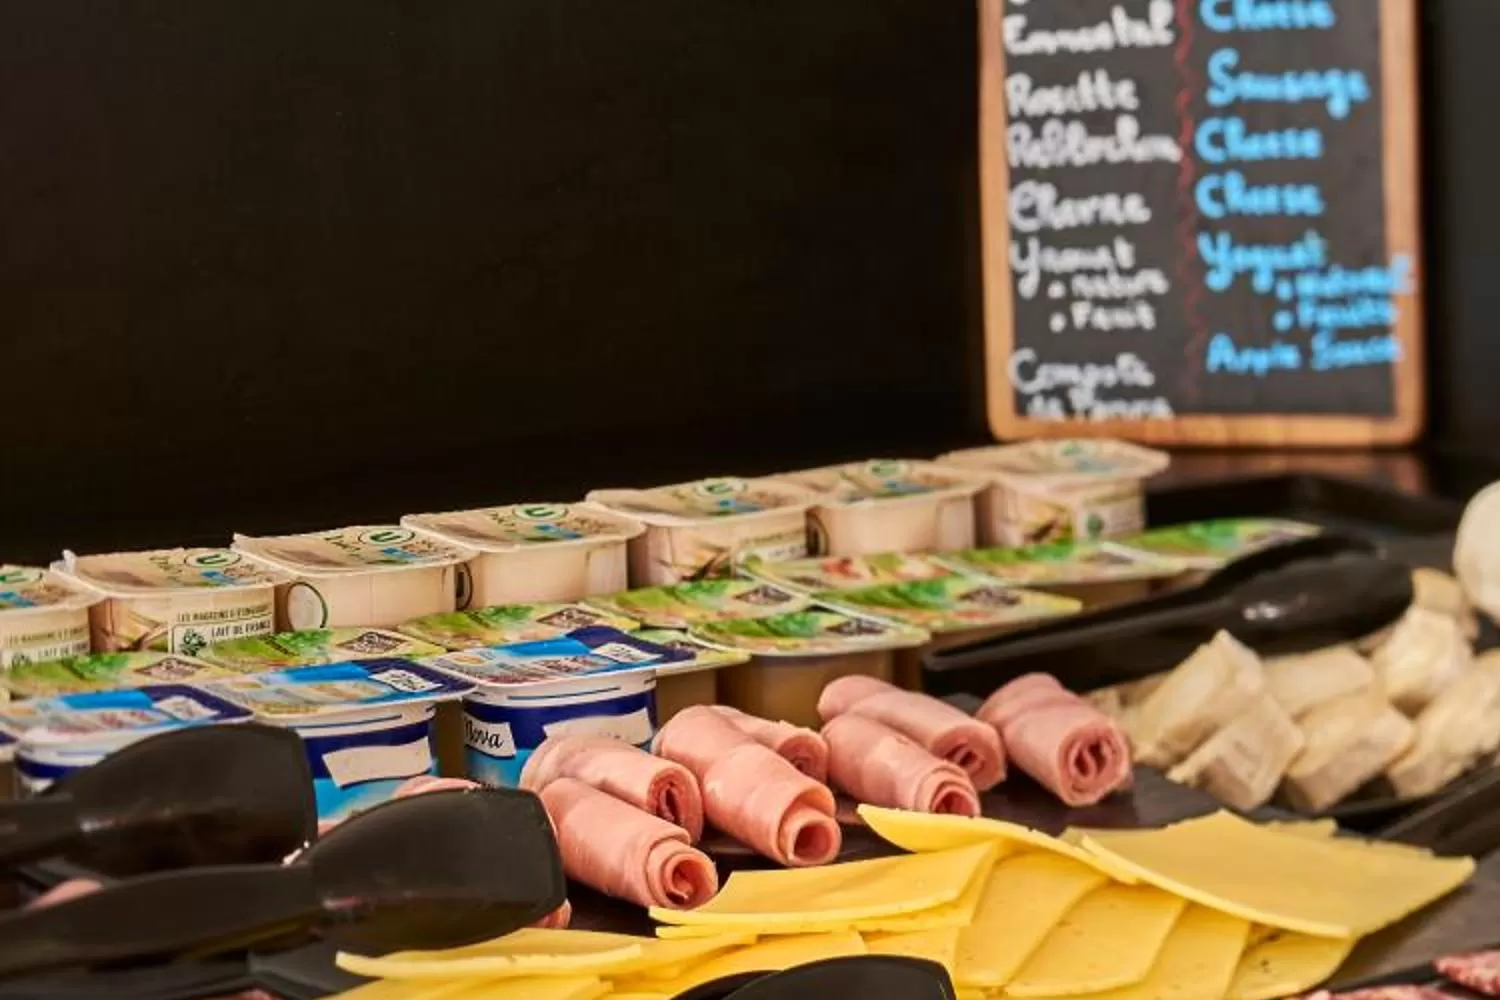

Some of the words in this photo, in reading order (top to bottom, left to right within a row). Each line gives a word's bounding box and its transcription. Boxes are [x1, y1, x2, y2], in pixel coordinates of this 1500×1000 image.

[1206, 48, 1371, 119] Sausage
[1195, 116, 1325, 163] Cheese
[1195, 170, 1325, 218] Cheese
